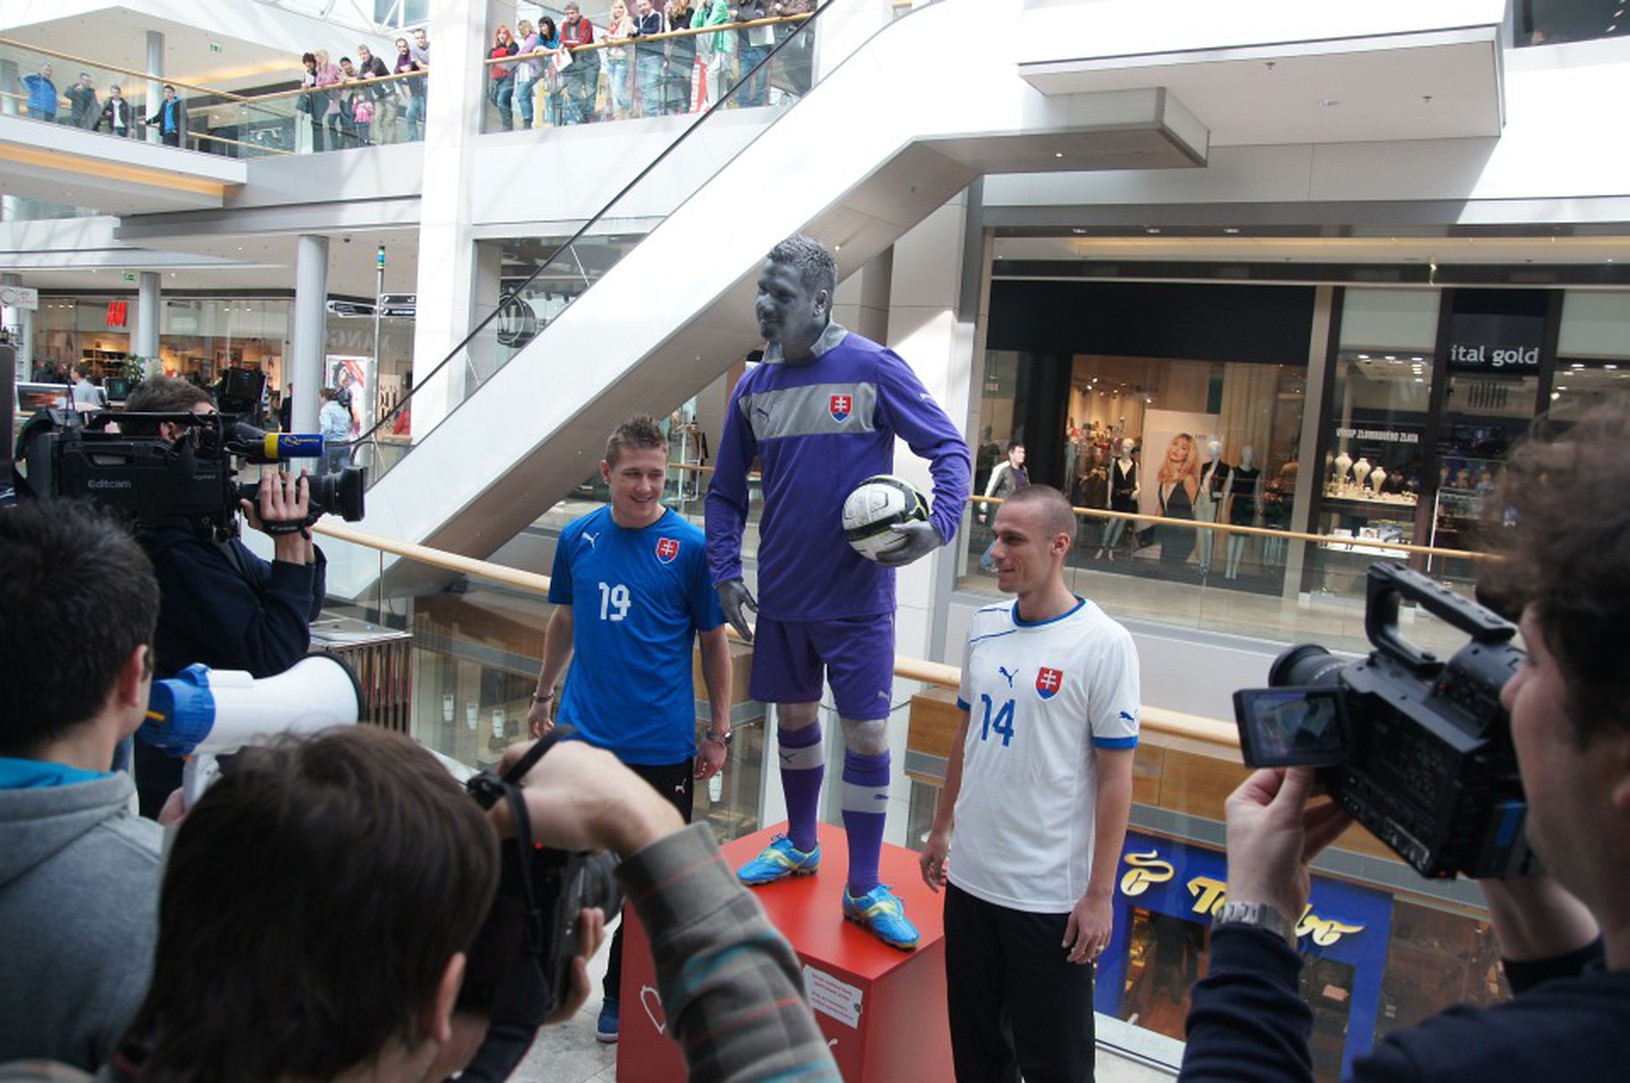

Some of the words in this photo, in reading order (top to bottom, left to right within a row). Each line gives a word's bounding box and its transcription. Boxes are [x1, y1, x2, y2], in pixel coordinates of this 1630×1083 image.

[1451, 344, 1485, 362] ital
[1492, 346, 1540, 367] gold
[598, 582, 631, 621] 19
[981, 693, 1015, 747] 14
[1186, 876, 1365, 947] Tbo
